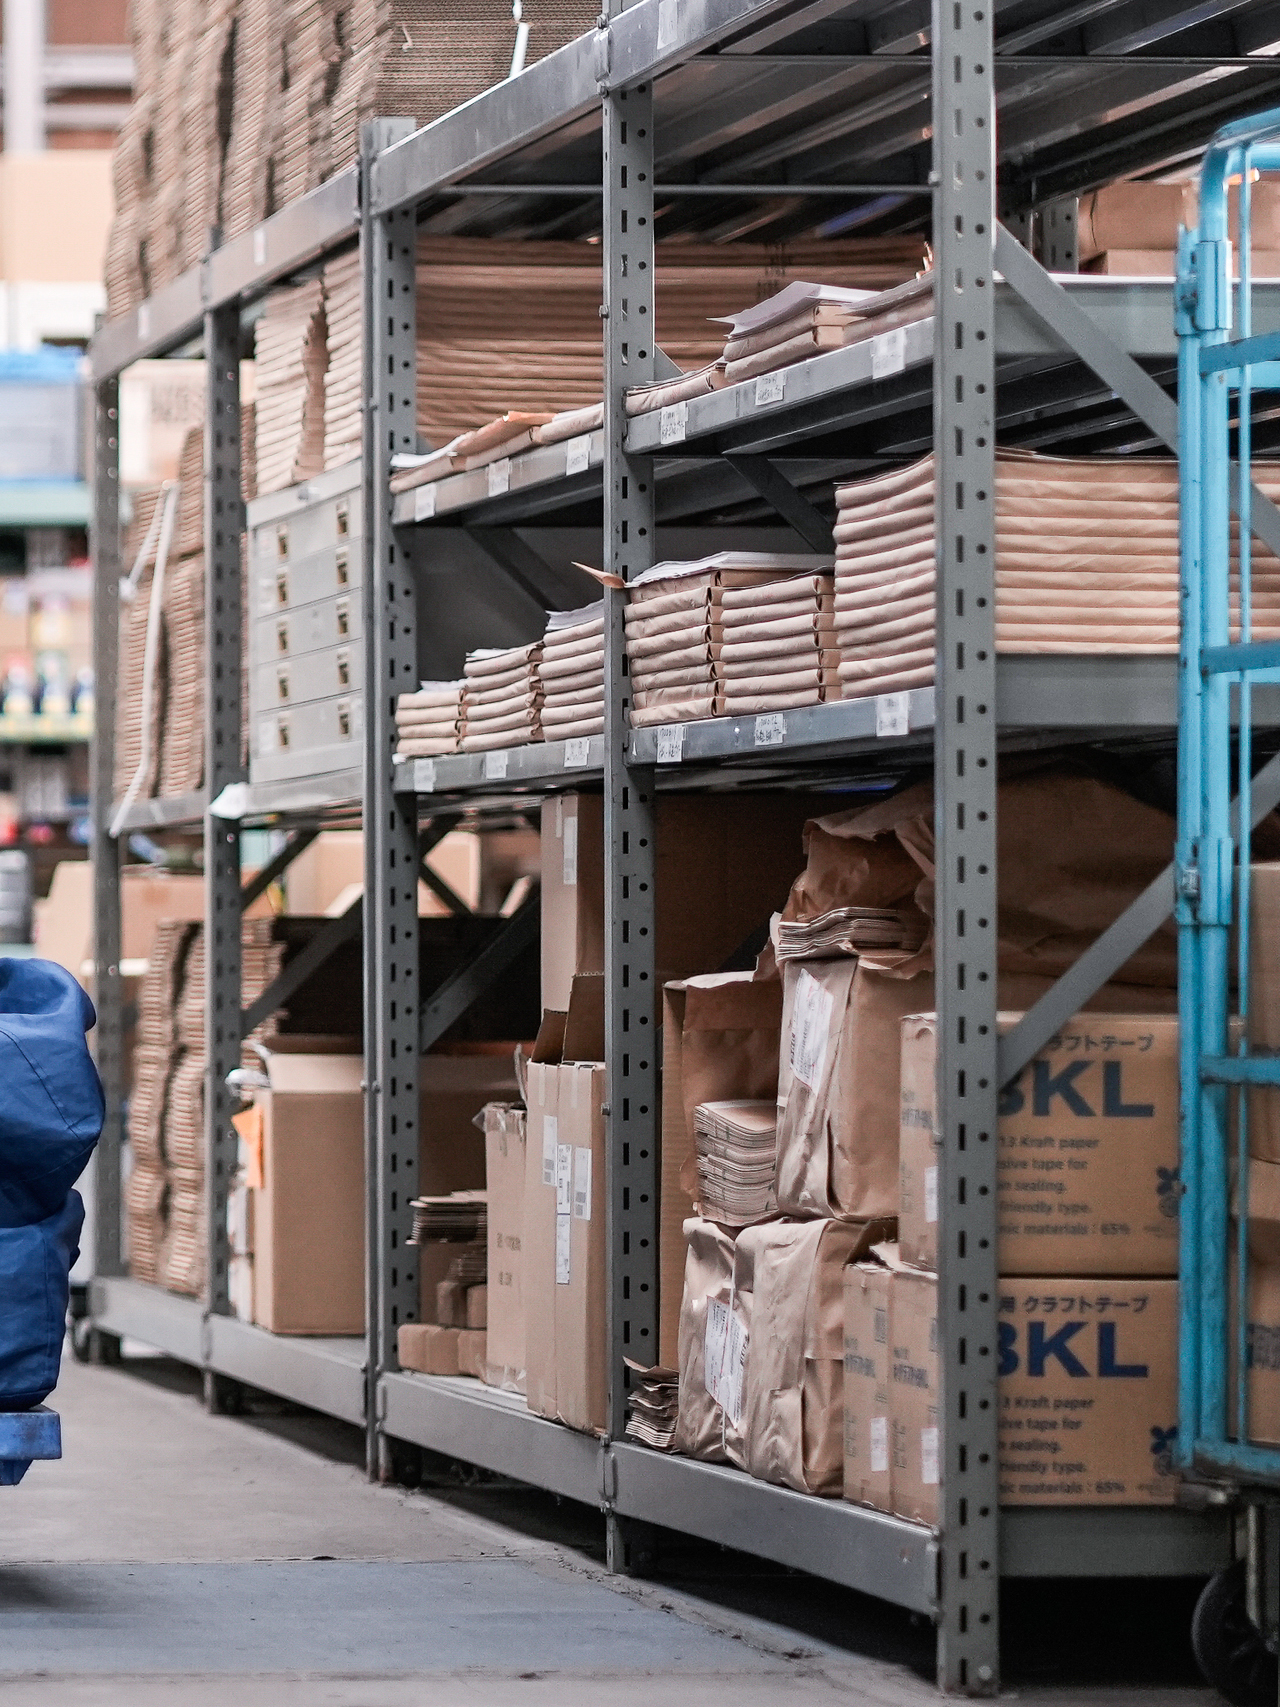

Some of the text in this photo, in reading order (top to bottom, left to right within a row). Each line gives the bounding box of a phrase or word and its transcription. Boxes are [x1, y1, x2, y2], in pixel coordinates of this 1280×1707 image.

[1059, 1138, 1100, 1150] paper
[1024, 1295, 1150, 1314] クラフトテープ
[1014, 1395, 1049, 1408] Kraft
[1054, 1398, 1095, 1411] paper
[1026, 1417, 1058, 1432] tape
[1062, 1417, 1082, 1429] for
